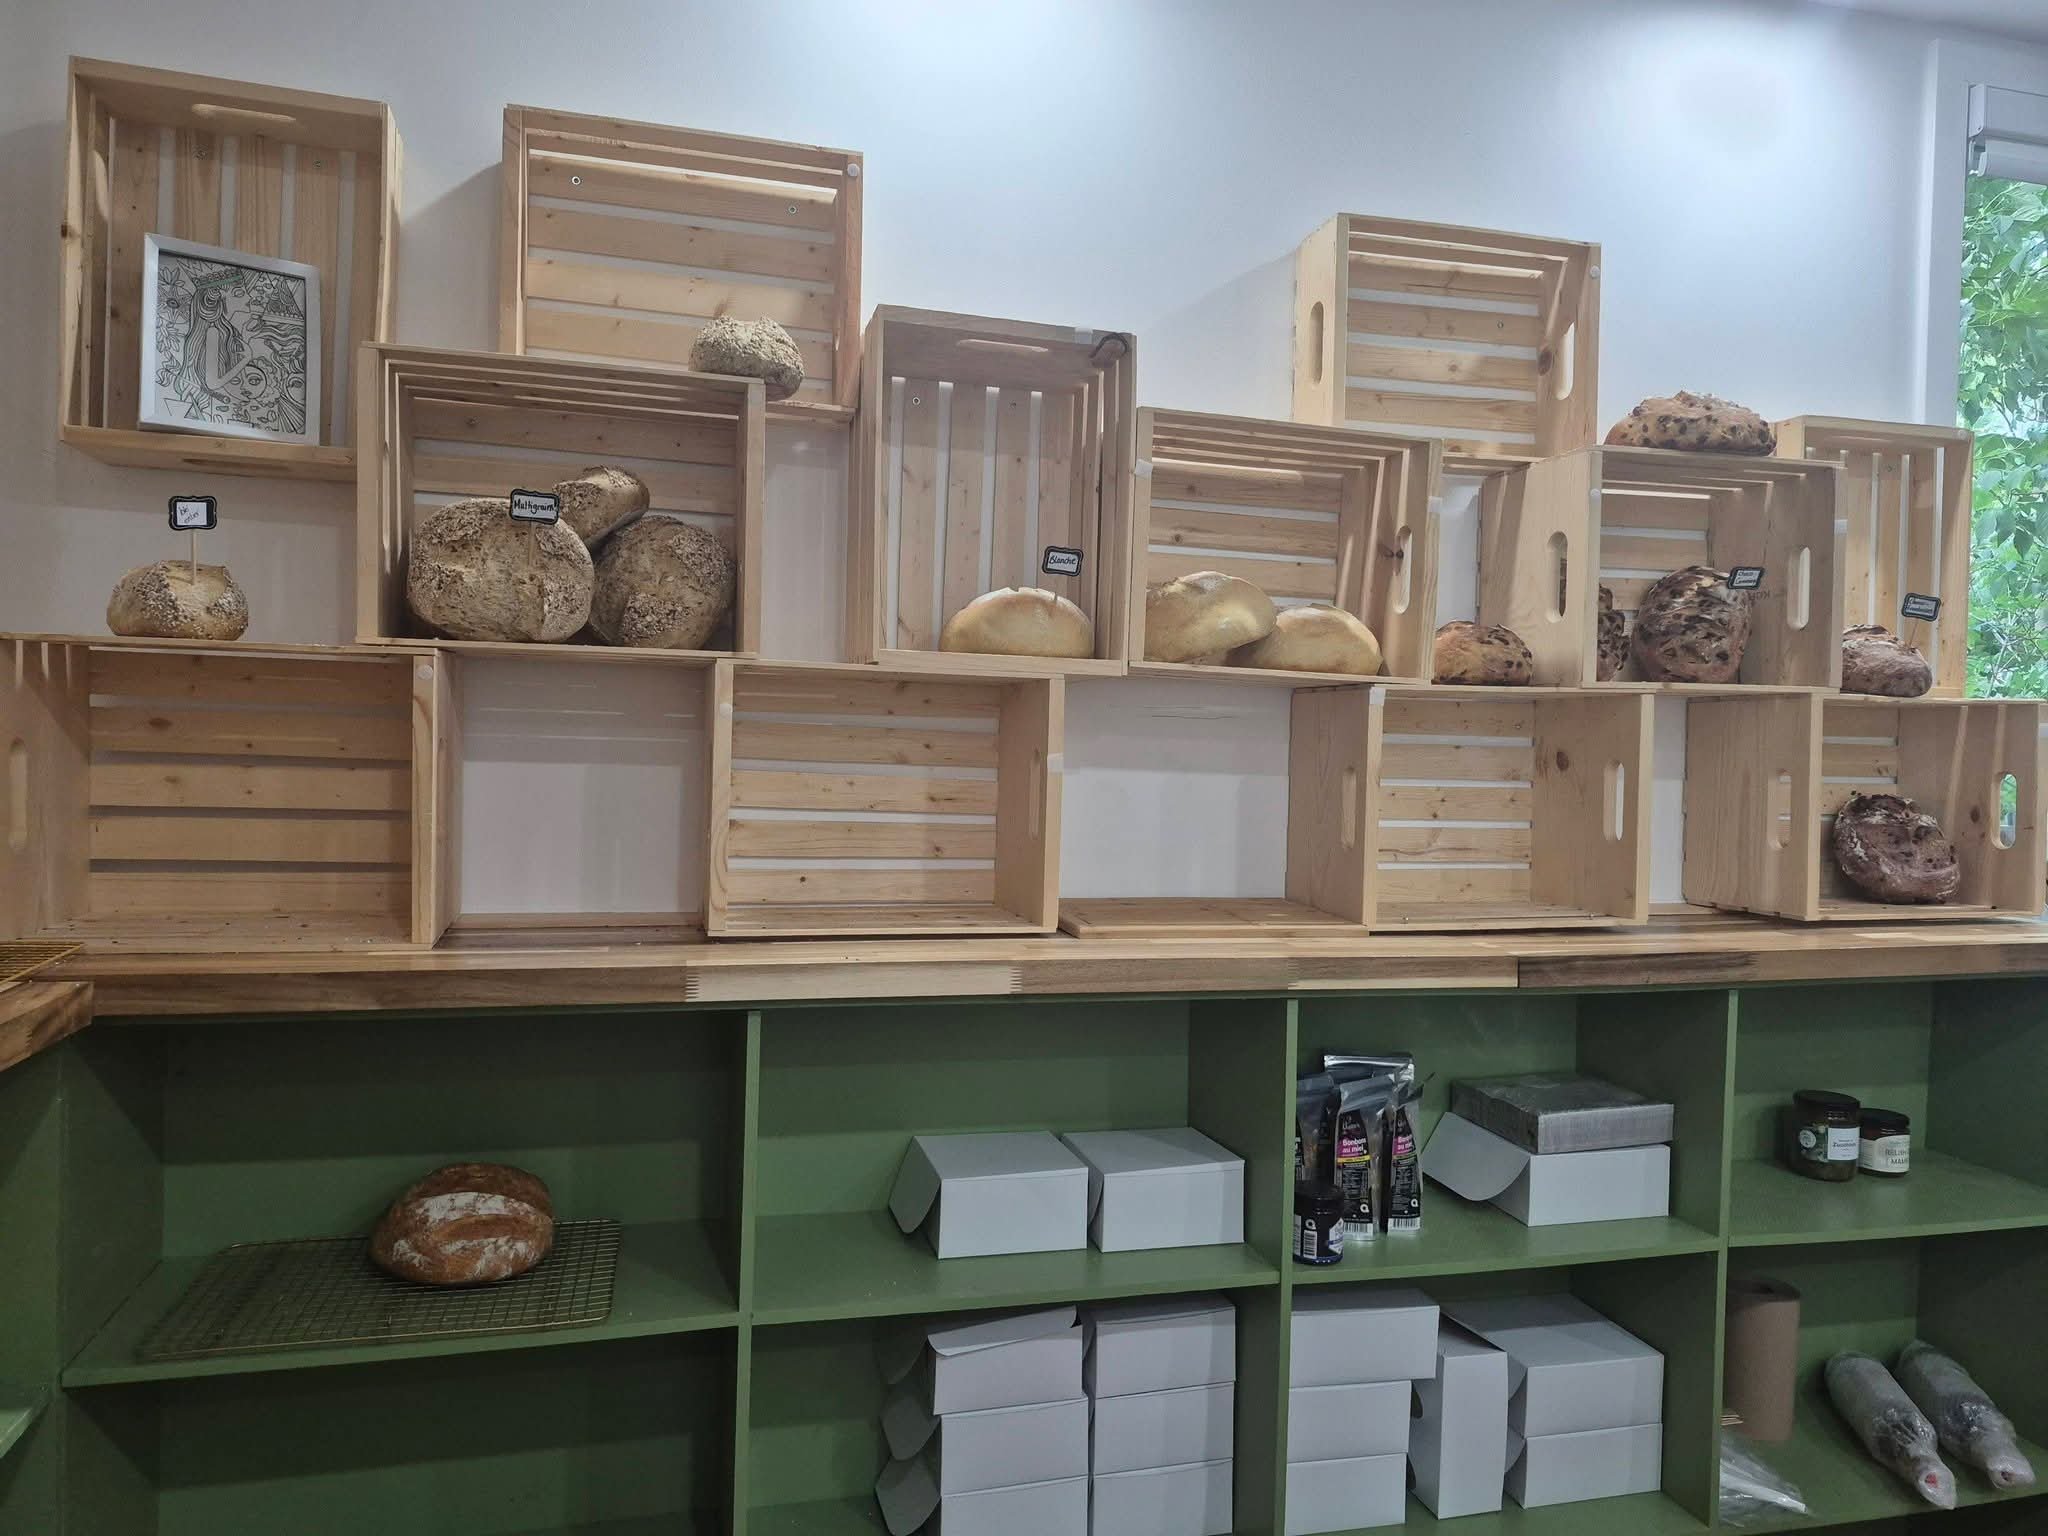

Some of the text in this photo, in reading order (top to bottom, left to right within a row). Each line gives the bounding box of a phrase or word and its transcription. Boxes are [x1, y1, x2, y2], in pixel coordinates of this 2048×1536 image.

[1048, 554, 1076, 565] Blanche
[1342, 1137, 1367, 1147] Bonbons
[1351, 1145, 1364, 1153] miel
